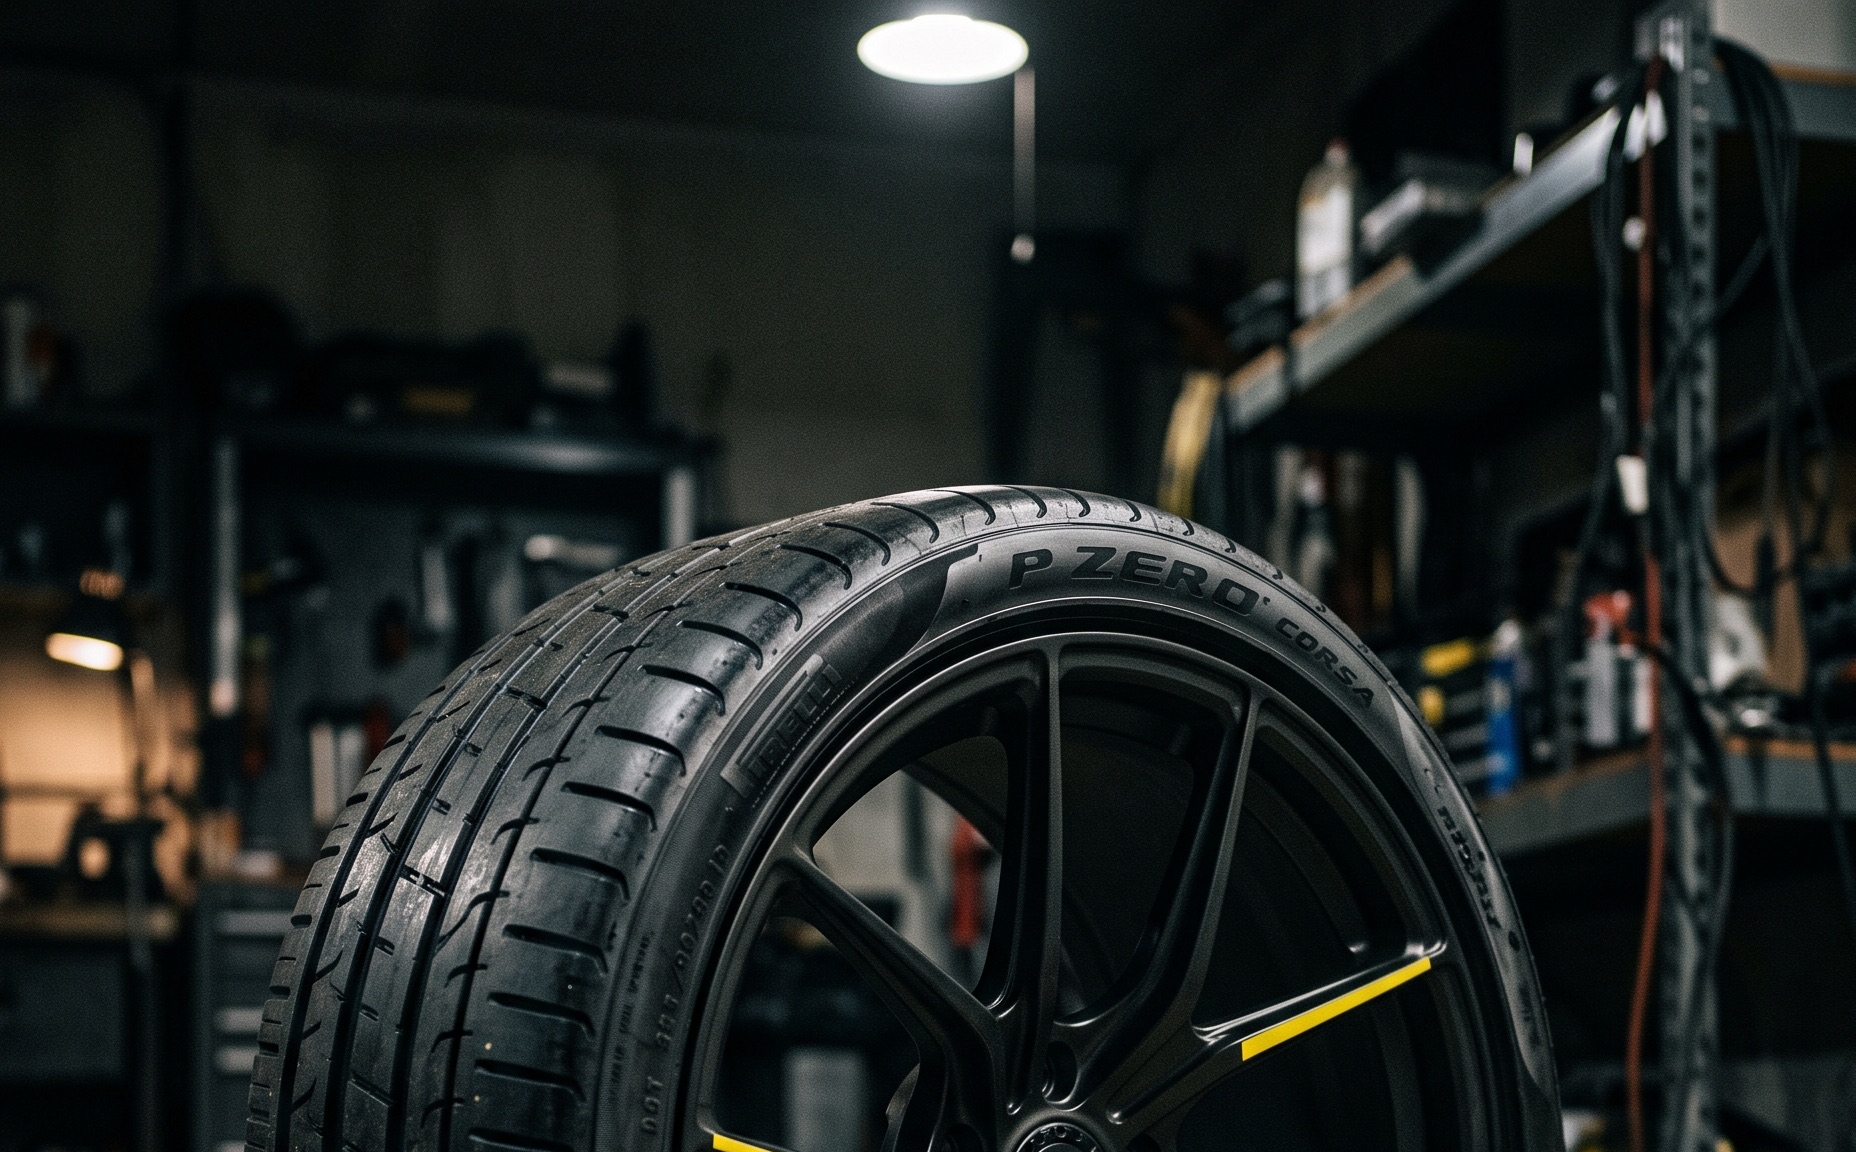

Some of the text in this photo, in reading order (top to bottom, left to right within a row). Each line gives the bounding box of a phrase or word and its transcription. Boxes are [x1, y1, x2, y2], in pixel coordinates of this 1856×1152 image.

[1009, 546, 1261, 617] P ZERO
[1275, 617, 1375, 710] CORSA
